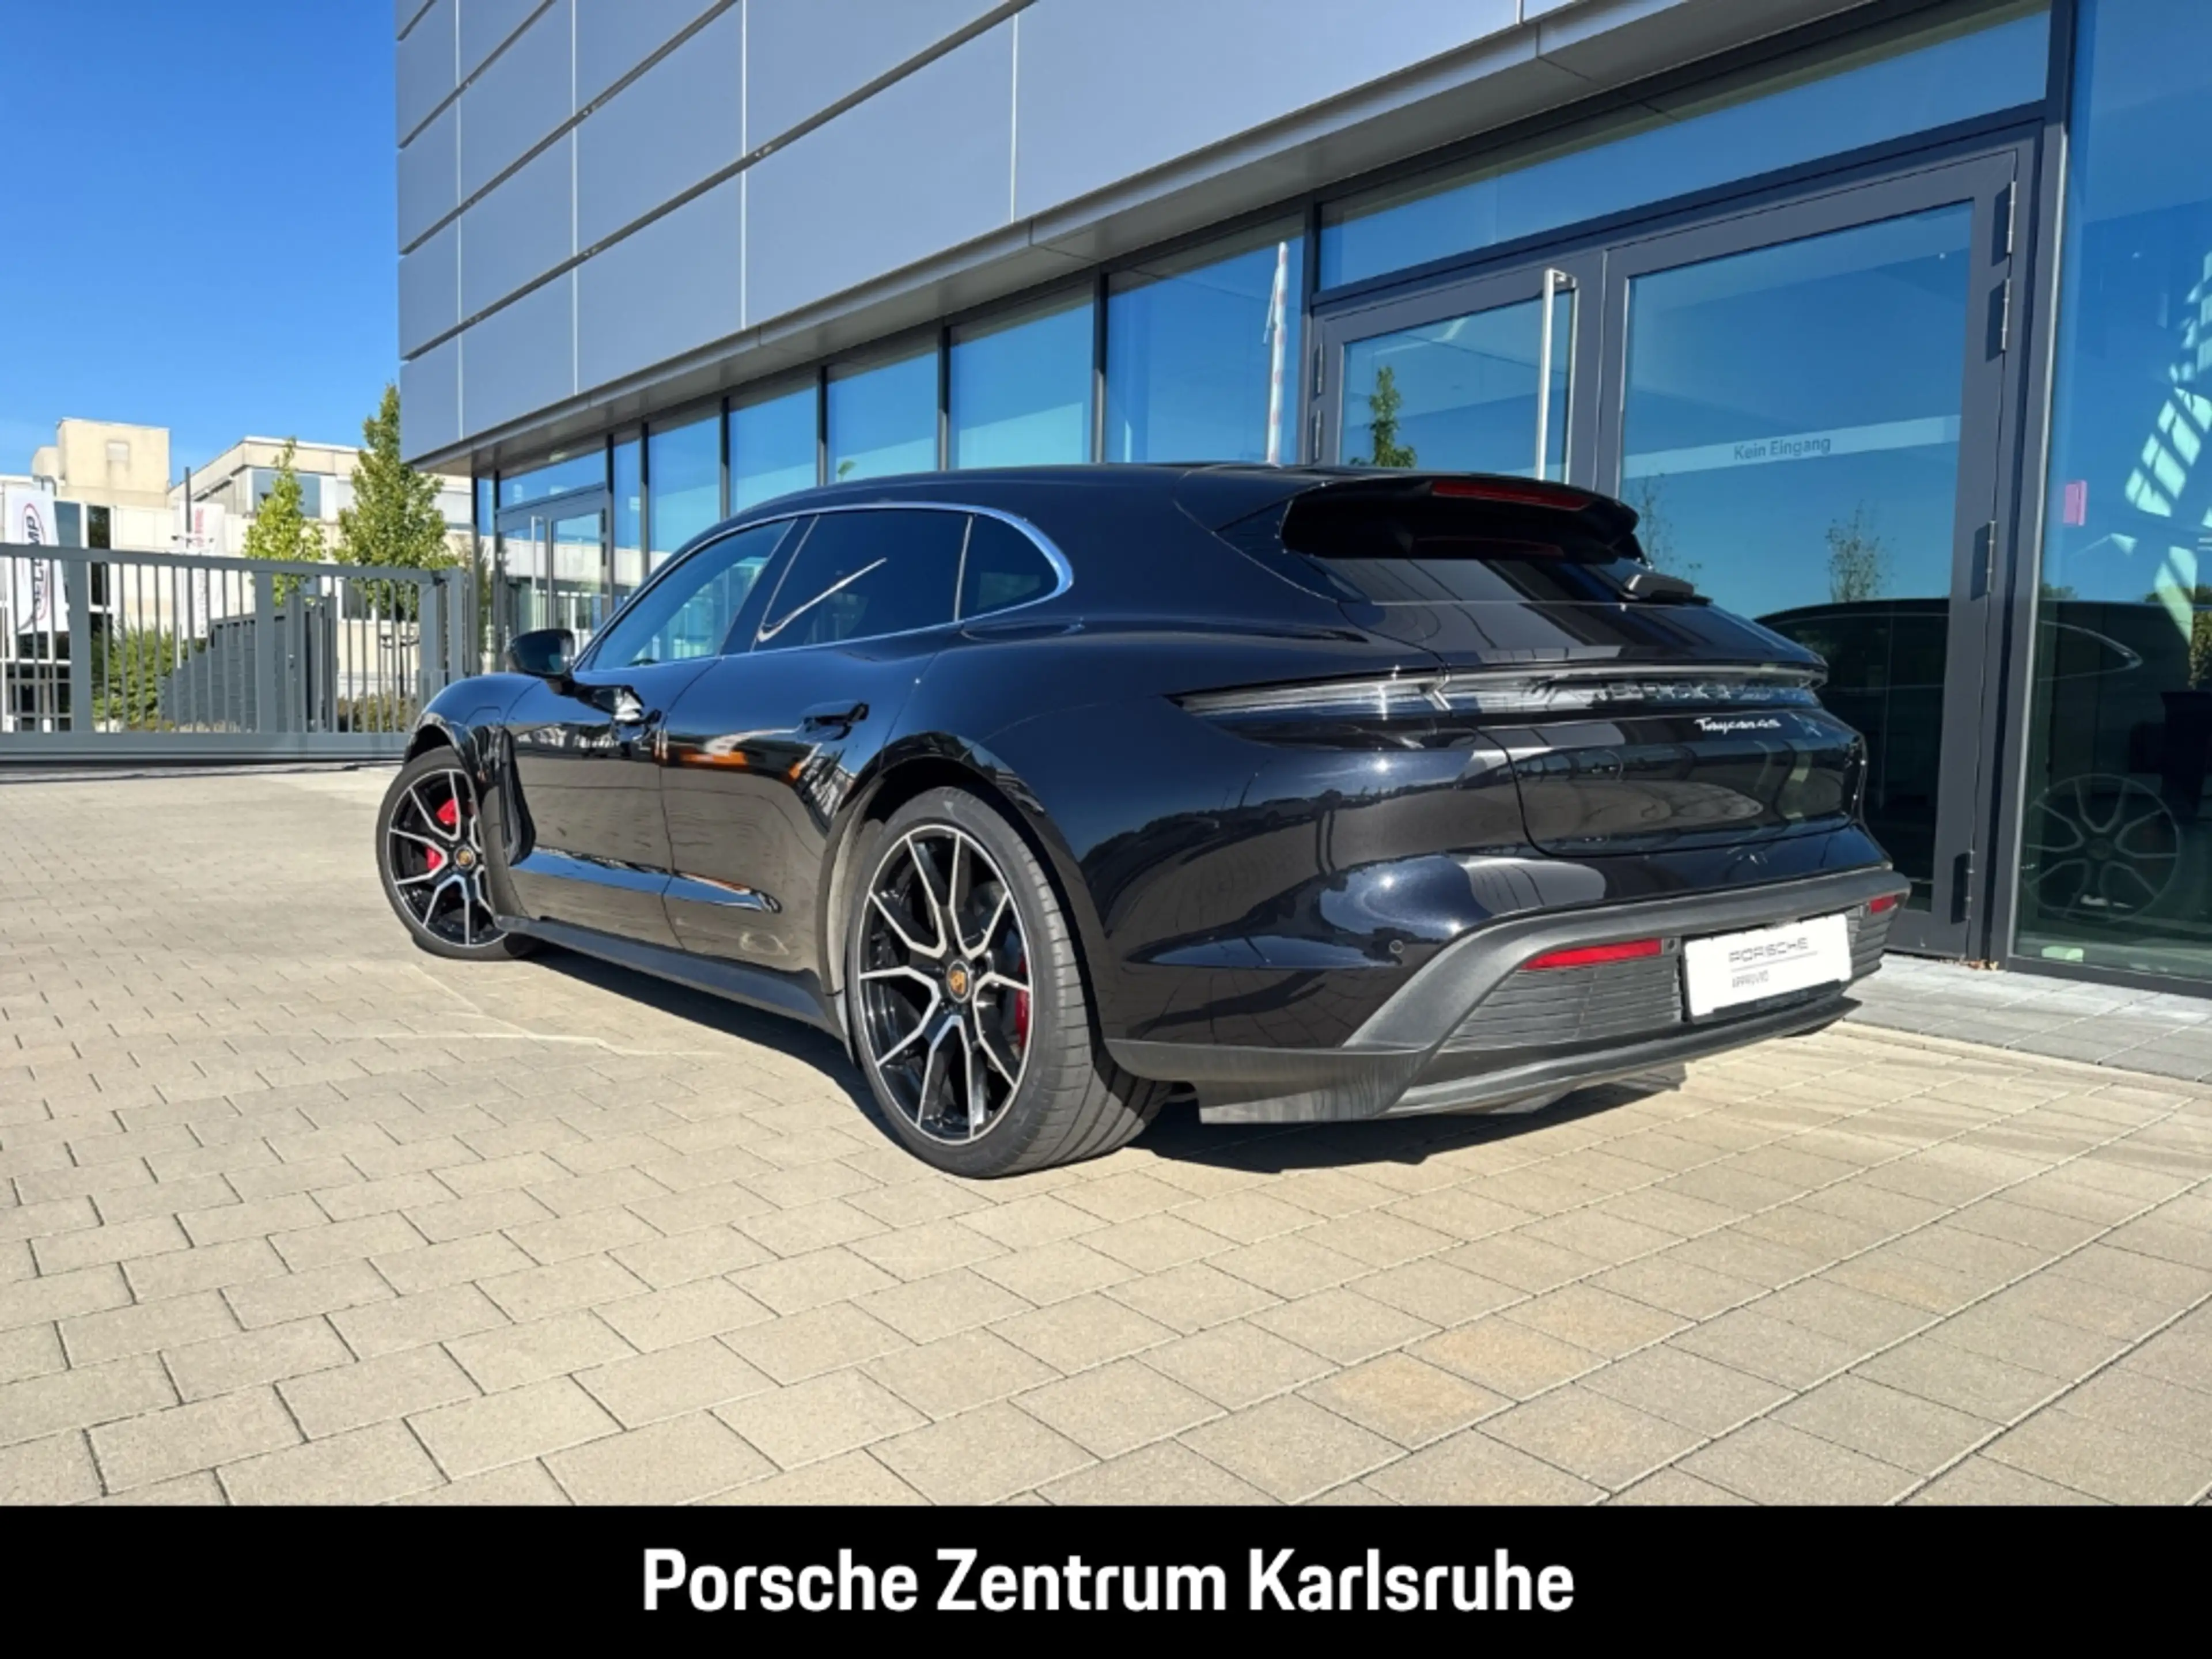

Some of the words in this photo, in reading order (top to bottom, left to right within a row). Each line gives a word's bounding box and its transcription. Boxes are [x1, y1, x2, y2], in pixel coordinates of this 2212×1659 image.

[1733, 442, 1766, 460] Kein
[1769, 438, 1831, 457] Eingang
[1693, 717, 1756, 735] Taycan
[1729, 937, 1809, 963] PORSCHE
